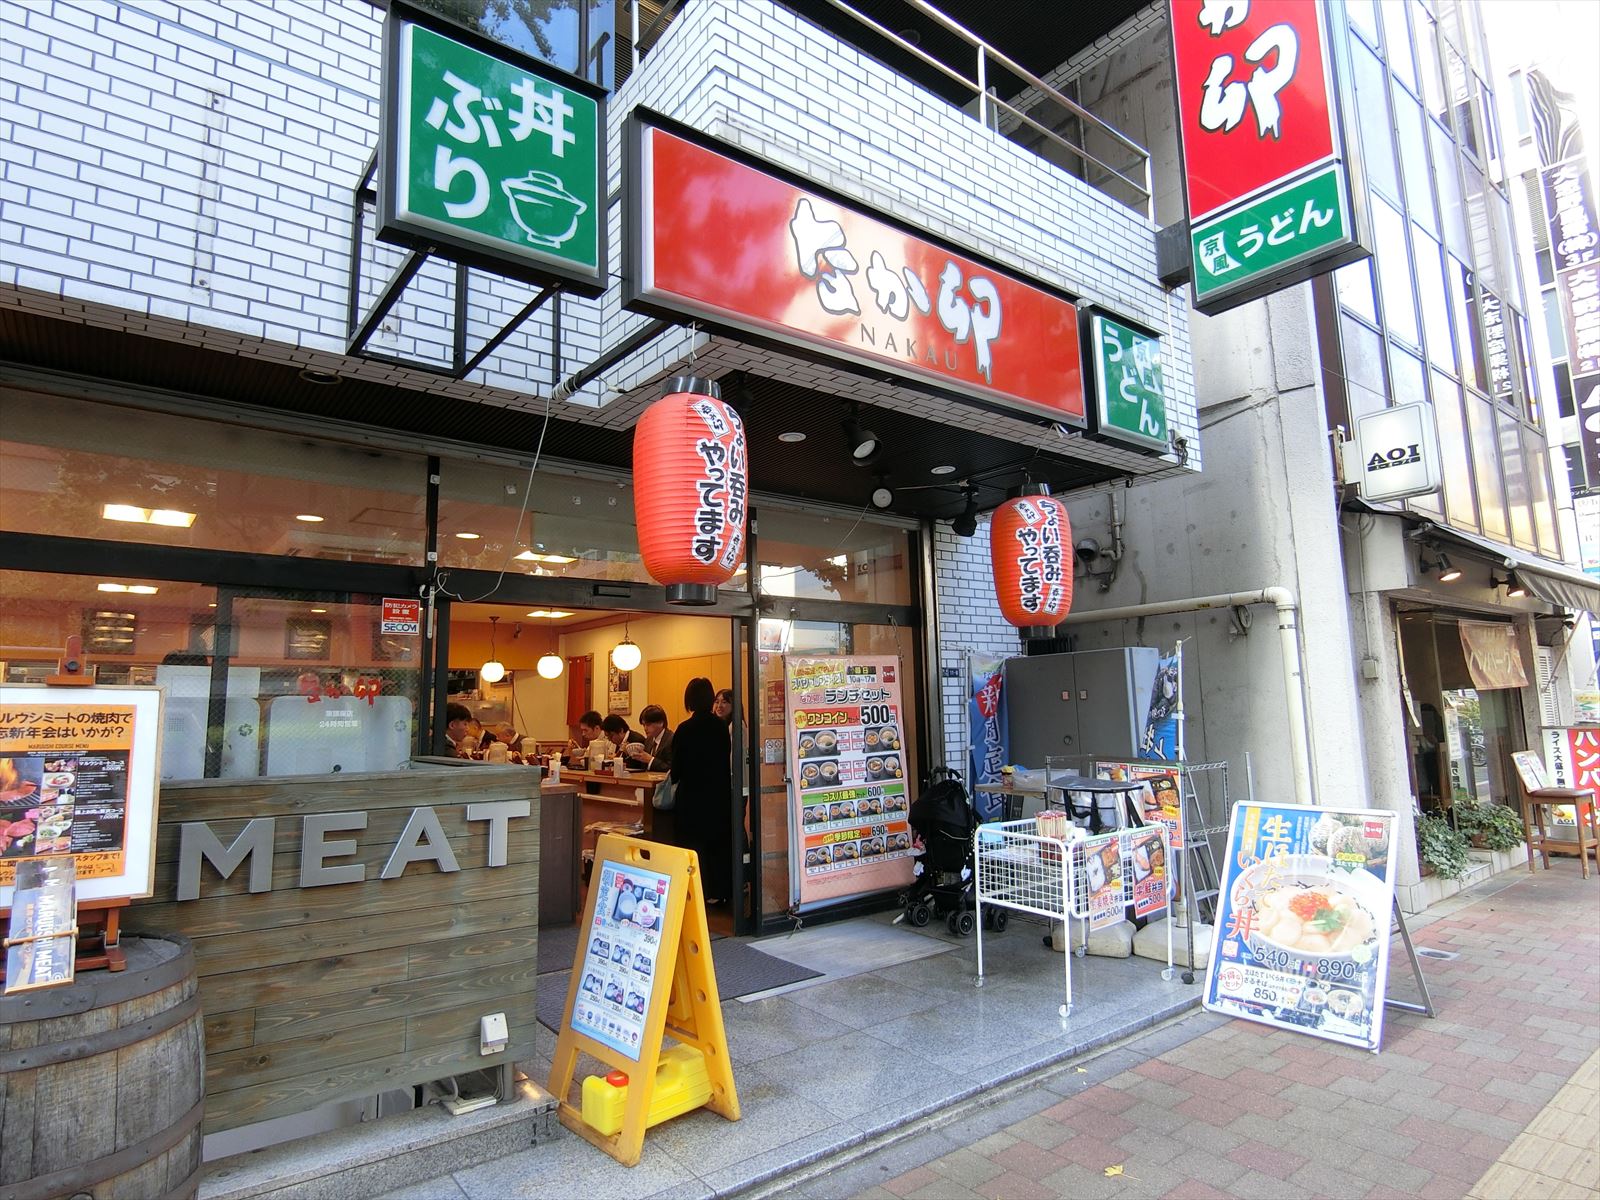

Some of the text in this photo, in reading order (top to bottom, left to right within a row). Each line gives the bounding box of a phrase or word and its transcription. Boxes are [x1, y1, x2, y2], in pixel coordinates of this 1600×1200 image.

[1204, 199, 1334, 273] 京風 うどん
[788, 197, 1002, 384] なか卯
[860, 323, 958, 371] NAKAU
[1104, 325, 1159, 437] うどん
[1367, 444, 1420, 465] AOI
[695, 440, 727, 564] やってます
[1038, 499, 1062, 583] ちょい呑み
[1016, 527, 1041, 612] やってます
[384, 623, 418, 633] SECOM
[1551, 731, 1566, 788] ライス大盛り無
[176, 800, 532, 903] MEAT
[1226, 850, 1261, 941] いくら丼
